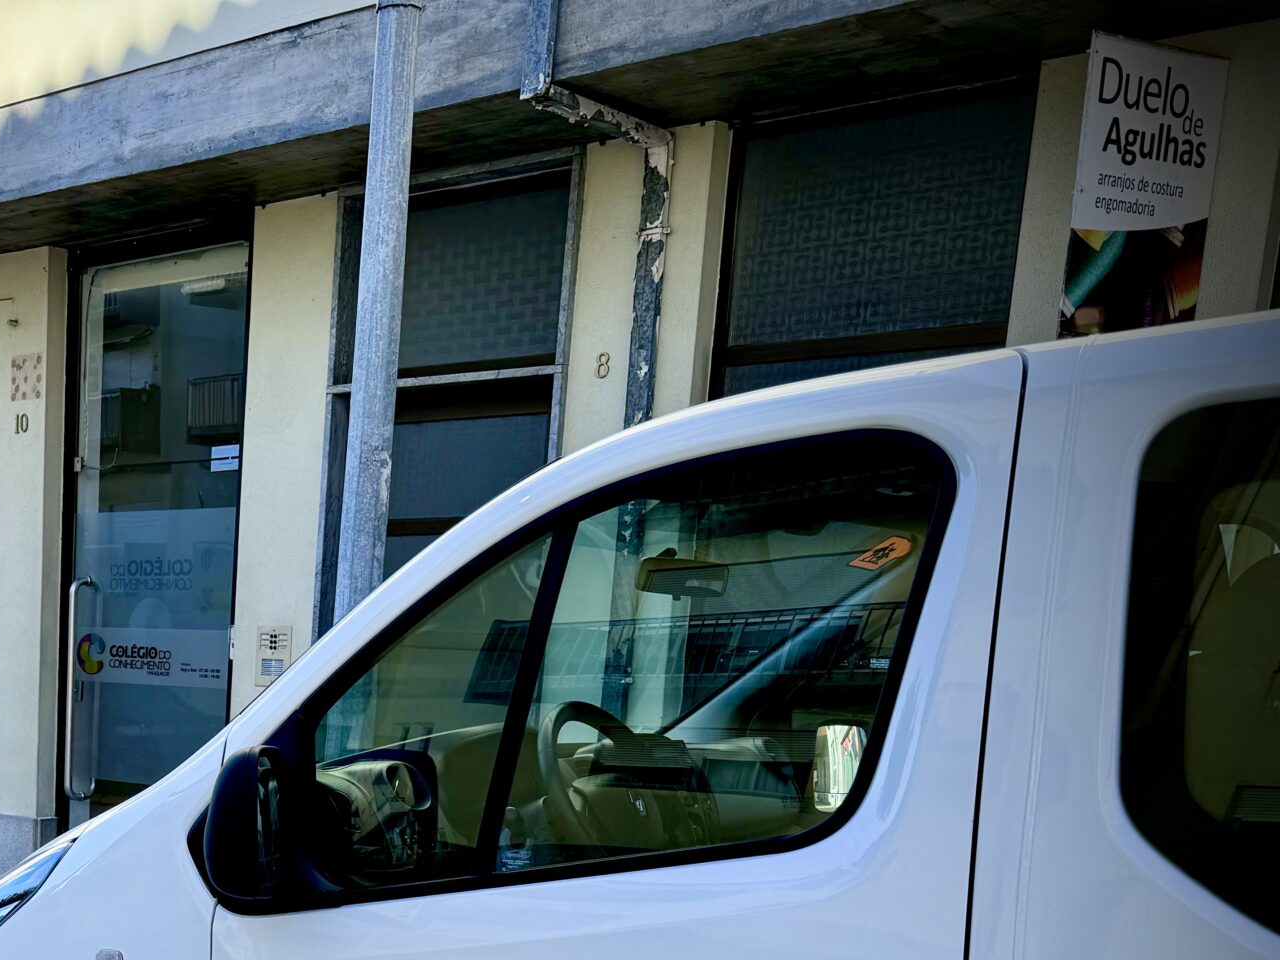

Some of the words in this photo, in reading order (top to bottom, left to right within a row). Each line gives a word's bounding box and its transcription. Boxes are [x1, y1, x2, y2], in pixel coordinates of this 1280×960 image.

[1098, 57, 1190, 119] Duelo
[1182, 109, 1204, 137] de
[1102, 116, 1207, 168] Agulhas
[1097, 172, 1136, 194] arranjos
[1137, 178, 1149, 193] de
[1150, 182, 1184, 198] costura
[1095, 197, 1156, 217] engomadoria
[596, 351, 610, 379] 8
[14, 413, 29, 434] 10
[109, 644, 158, 659] COLÉGIO
[158, 650, 172, 660] DO
[109, 659, 171, 671] CONHECIMENTO
